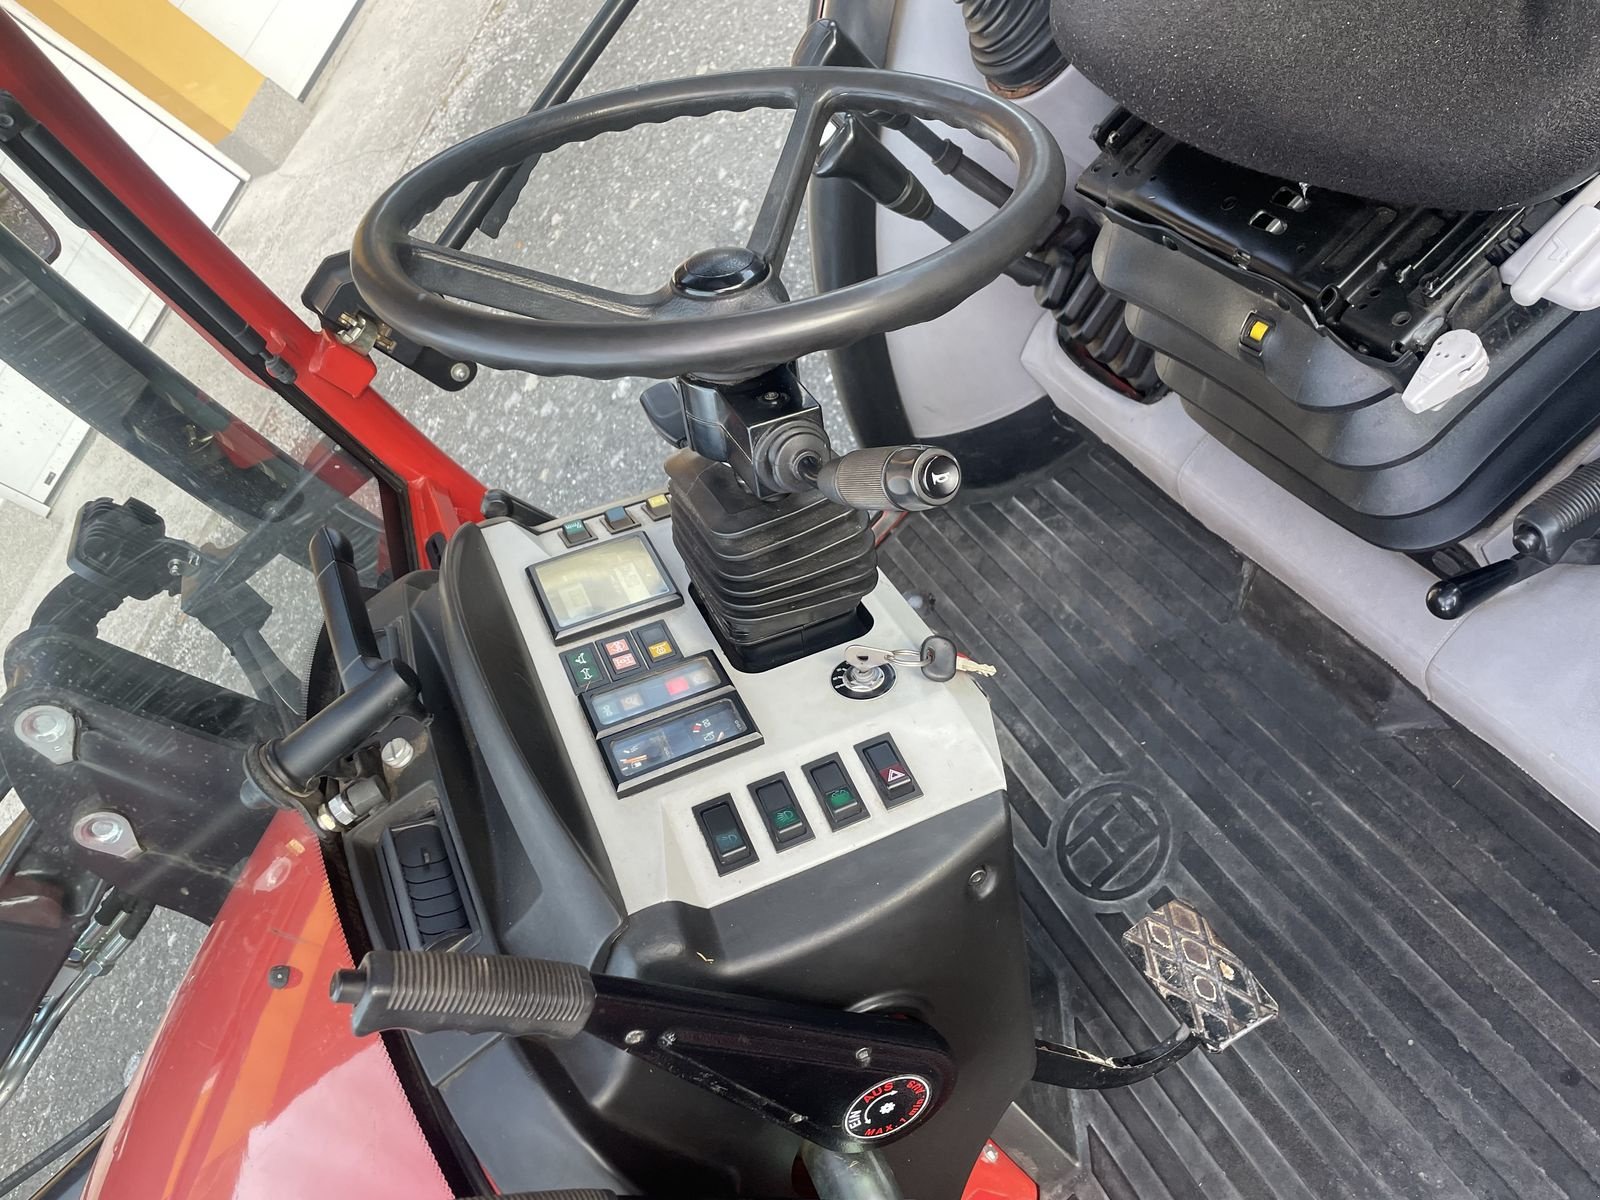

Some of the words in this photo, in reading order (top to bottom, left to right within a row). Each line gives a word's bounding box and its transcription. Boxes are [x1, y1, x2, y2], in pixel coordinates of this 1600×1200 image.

[863, 1081, 894, 1103] AUS
[906, 1080, 926, 1095] AUS
[849, 1109, 862, 1130] EIN
